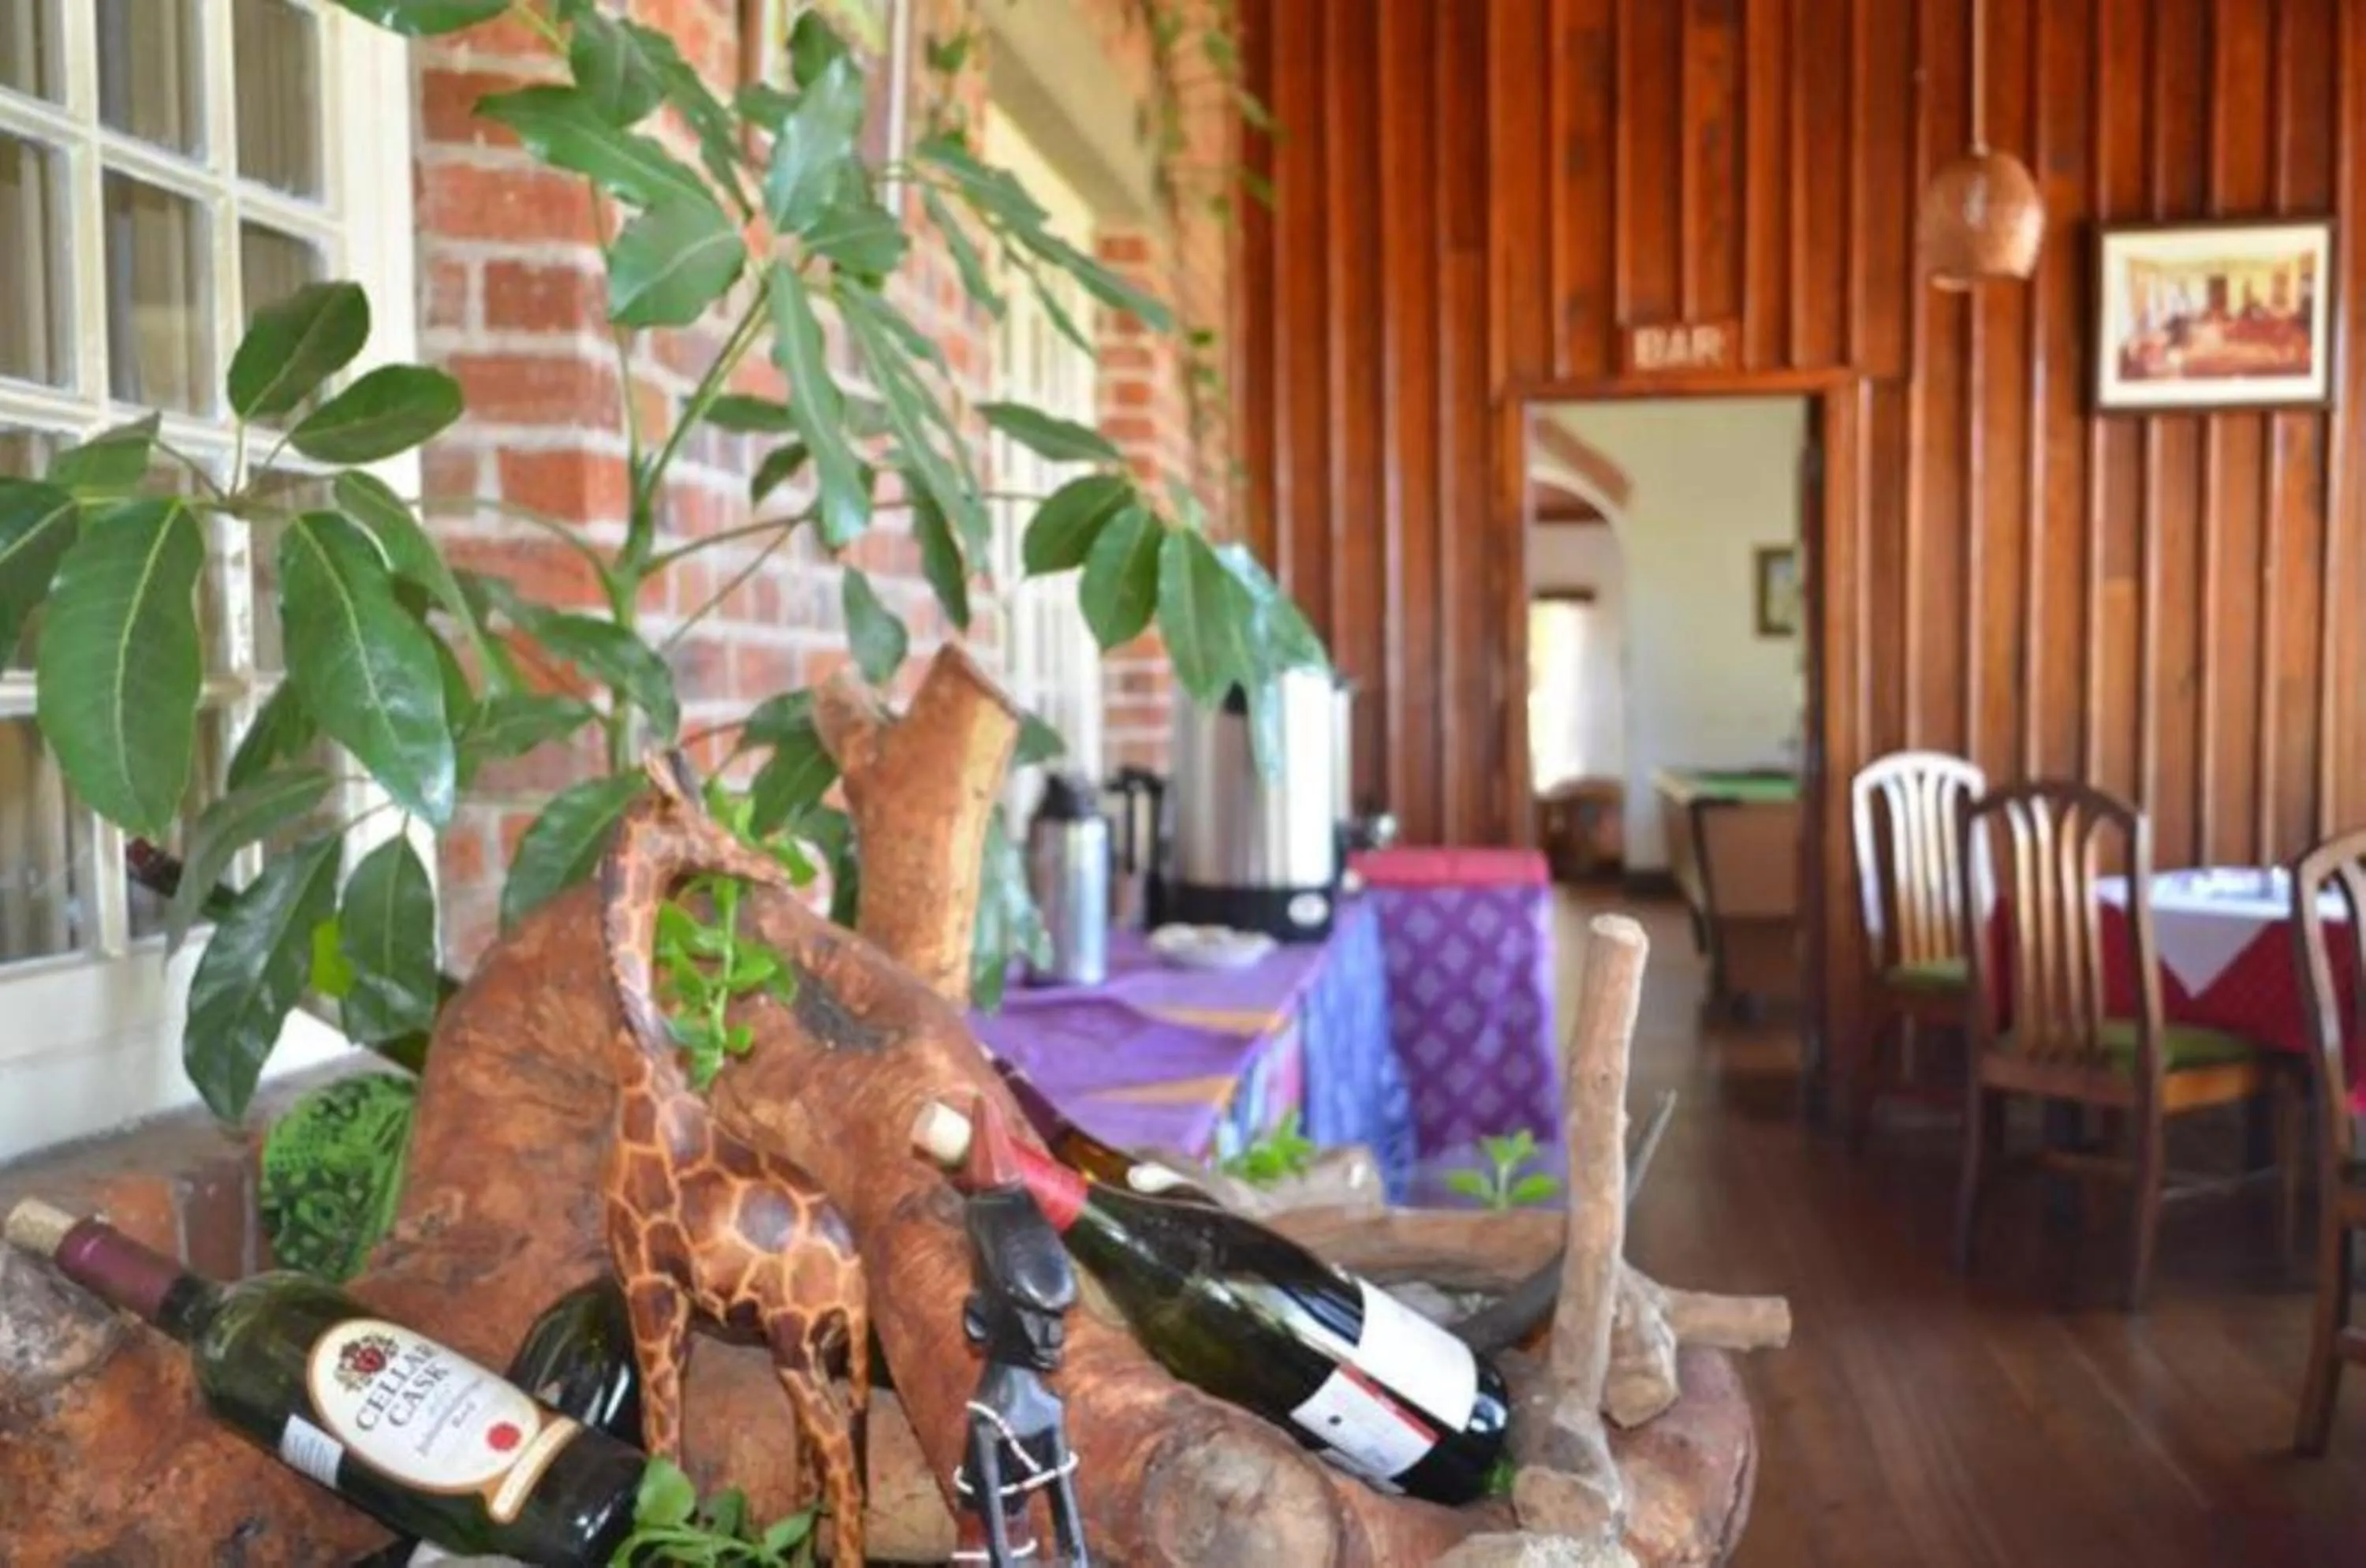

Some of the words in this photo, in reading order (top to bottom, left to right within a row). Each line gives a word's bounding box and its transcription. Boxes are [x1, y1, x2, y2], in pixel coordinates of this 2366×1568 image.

[1634, 326, 1724, 371] BAR
[356, 1343, 435, 1431] CELLAR
[389, 1362, 449, 1426] CASK
